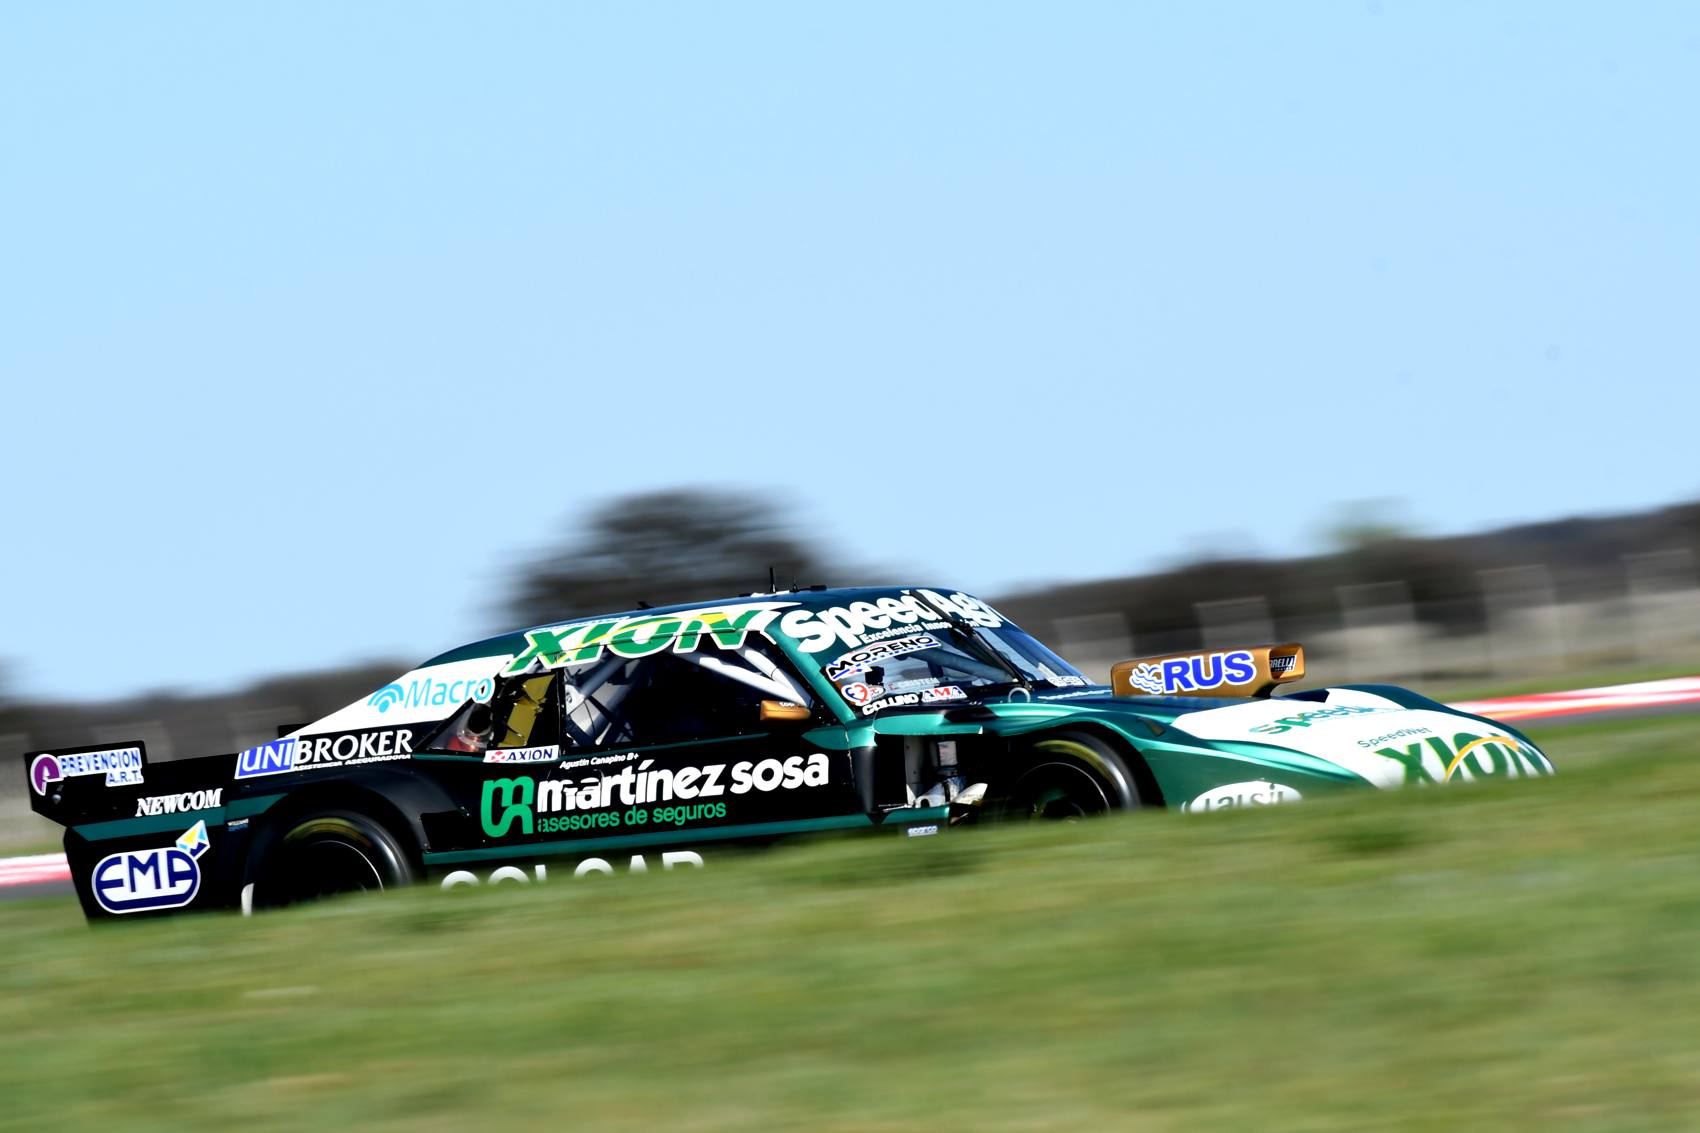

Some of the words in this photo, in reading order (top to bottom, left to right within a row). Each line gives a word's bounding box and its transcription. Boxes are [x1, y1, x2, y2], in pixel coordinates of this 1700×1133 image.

[503, 608, 764, 674] XION
[828, 636, 933, 677] MORENO
[1163, 652, 1255, 691] RUS
[404, 676, 491, 710] Macro
[862, 693, 919, 716] COLLINO
[923, 687, 963, 700] AMA
[1357, 726, 1433, 749] SpeedWet
[61, 750, 140, 773] PREVENCION
[506, 748, 554, 763] AXION
[537, 760, 727, 814] martínez
[730, 753, 830, 795] sosa
[135, 788, 223, 817] NEWCOM
[537, 804, 621, 833] asesores
[625, 805, 648, 826] de
[652, 801, 727, 827] seguros
[95, 849, 199, 912] EMA
